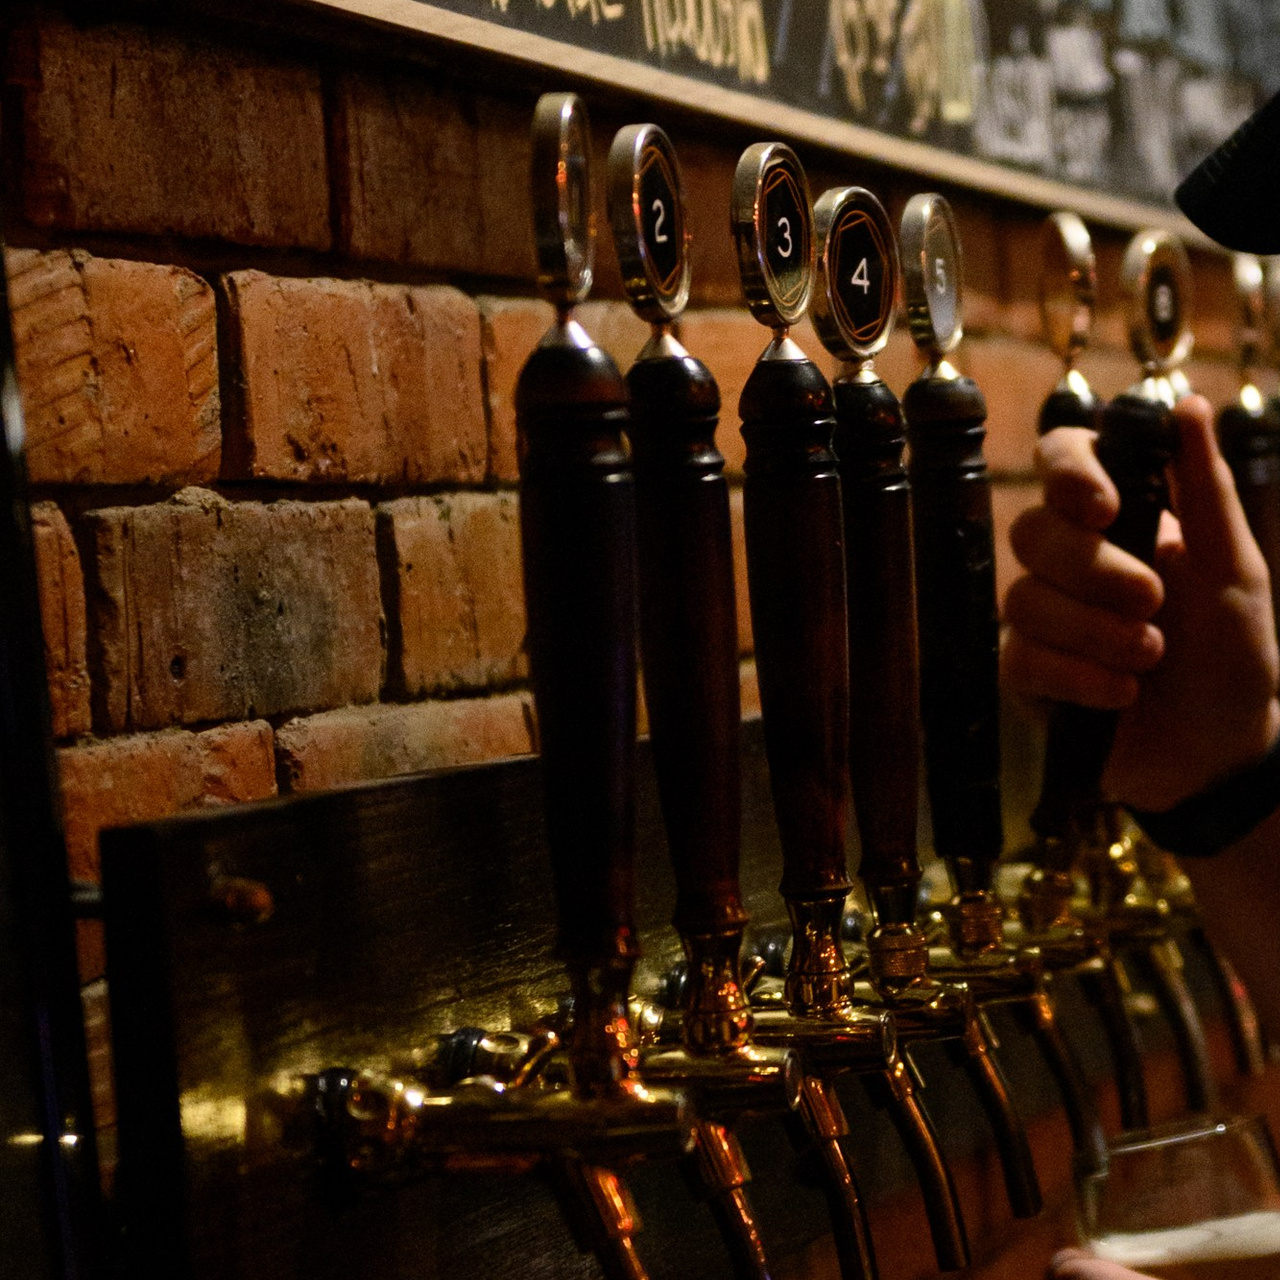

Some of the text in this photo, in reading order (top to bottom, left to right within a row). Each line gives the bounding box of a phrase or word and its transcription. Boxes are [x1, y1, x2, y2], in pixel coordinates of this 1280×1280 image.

[651, 199, 668, 243] 2
[777, 216, 793, 258] 3
[850, 256, 871, 295] 4
